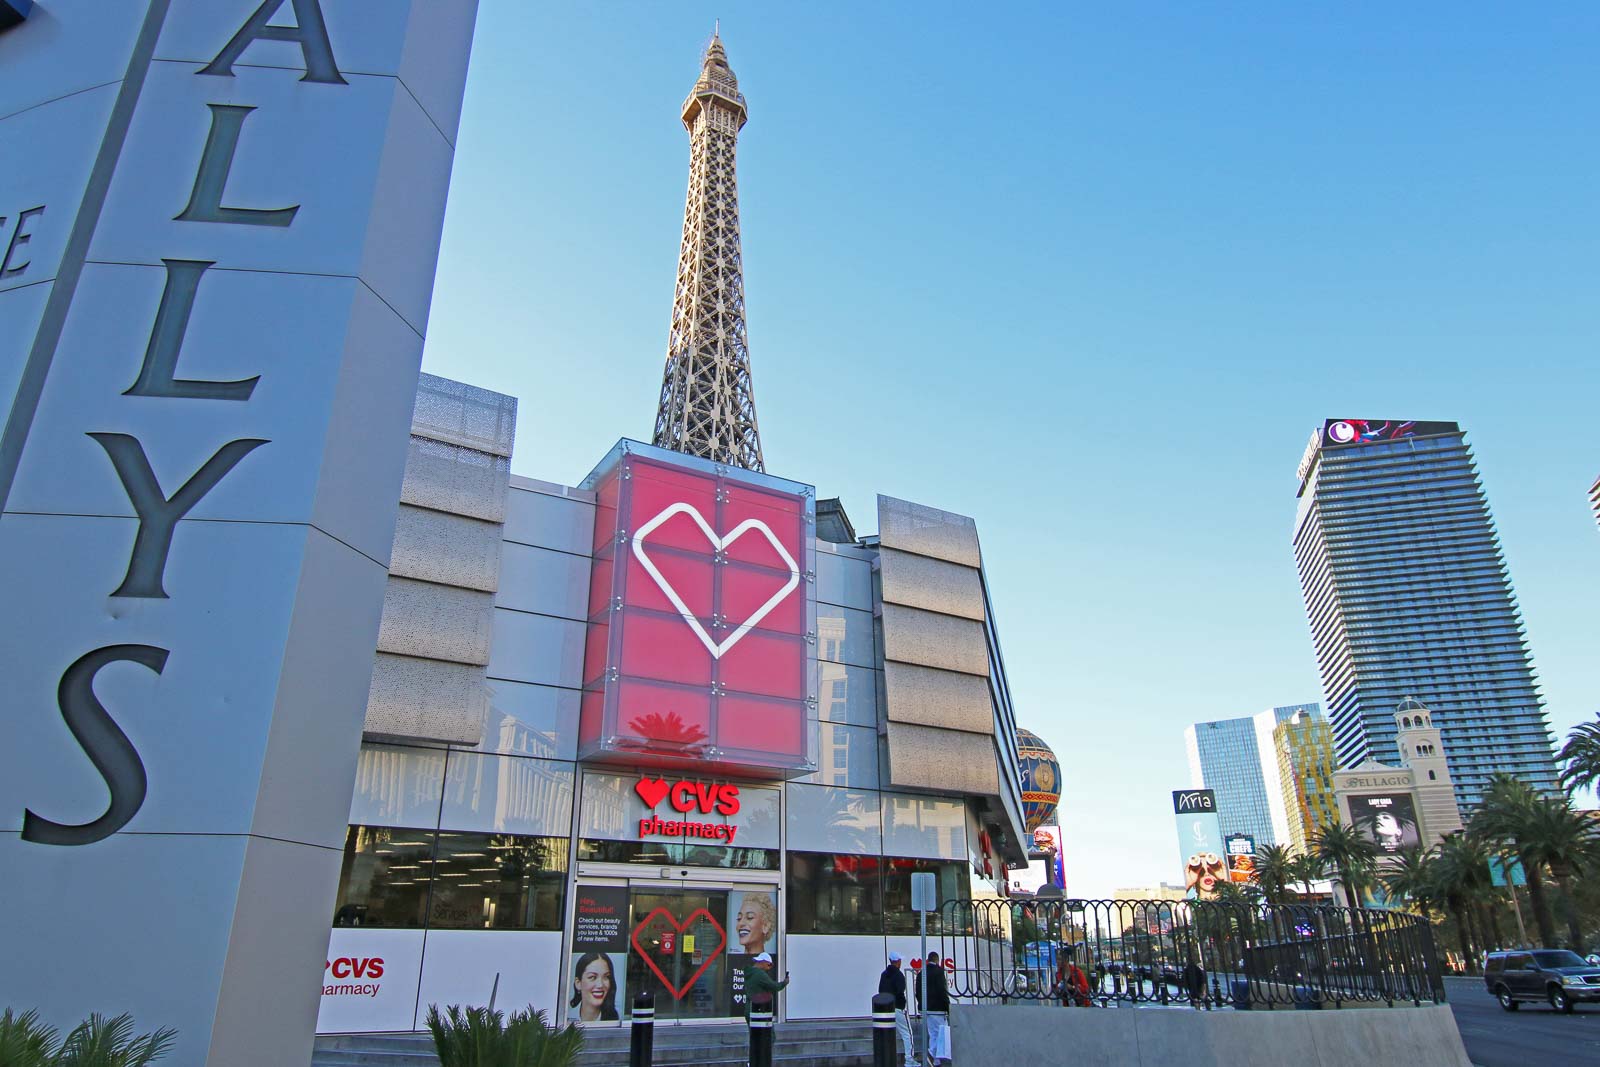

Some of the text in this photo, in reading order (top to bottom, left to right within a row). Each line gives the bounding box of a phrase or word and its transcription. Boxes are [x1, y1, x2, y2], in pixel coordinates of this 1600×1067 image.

[1344, 777, 1409, 788] BELLAGIO
[671, 781, 740, 816] CVS
[1179, 792, 1211, 810] Aria
[640, 815, 737, 844] pharmacy
[332, 957, 385, 979] CVS
